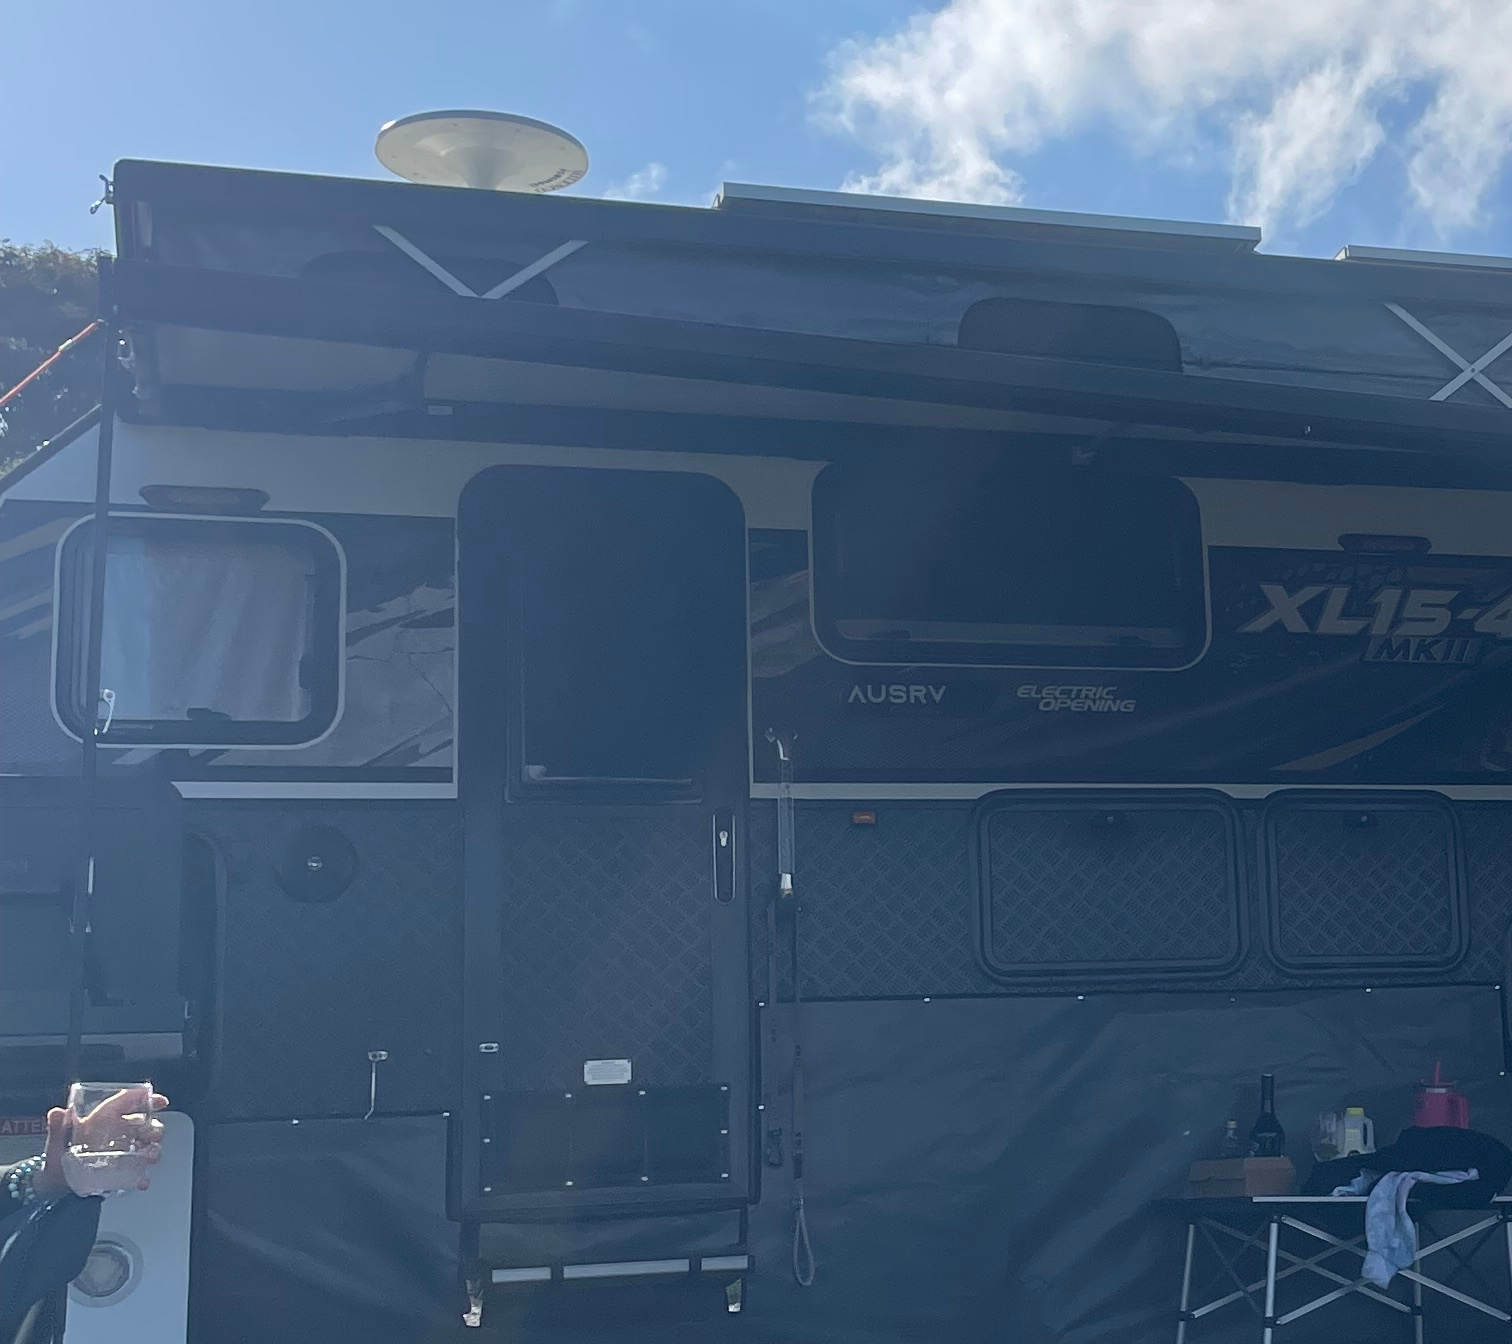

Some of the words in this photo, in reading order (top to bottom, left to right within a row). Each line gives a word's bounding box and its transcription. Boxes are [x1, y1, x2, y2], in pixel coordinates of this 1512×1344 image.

[1372, 638, 1470, 662] MKII
[847, 685, 948, 705] AUSRV
[1016, 684, 1118, 700] ELECTRIC
[1038, 698, 1138, 714] OPENING
[0, 1119, 48, 1134] ATTE
